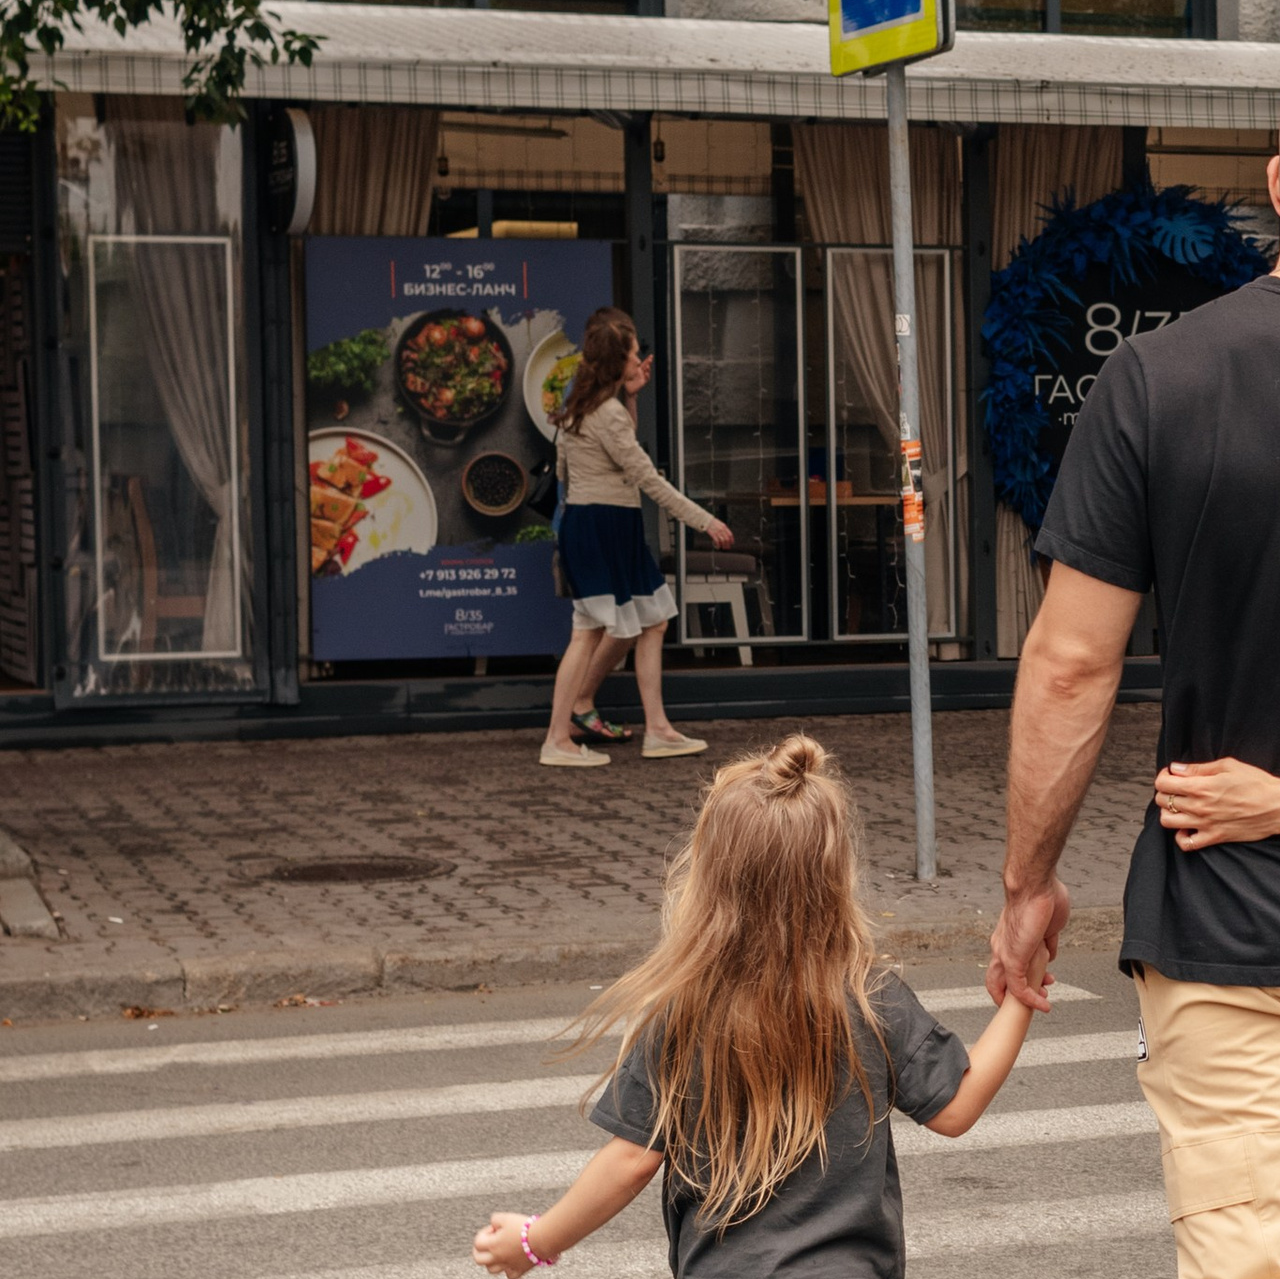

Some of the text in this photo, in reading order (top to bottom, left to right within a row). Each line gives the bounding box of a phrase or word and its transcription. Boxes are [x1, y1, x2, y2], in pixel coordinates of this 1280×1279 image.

[403, 283, 516, 296] БИЗНЕС-ЛАНЧ
[1085, 302, 1192, 356] 8/
[419, 568, 516, 581] +7 913 926 29 72
[455, 608, 483, 621] 8/35
